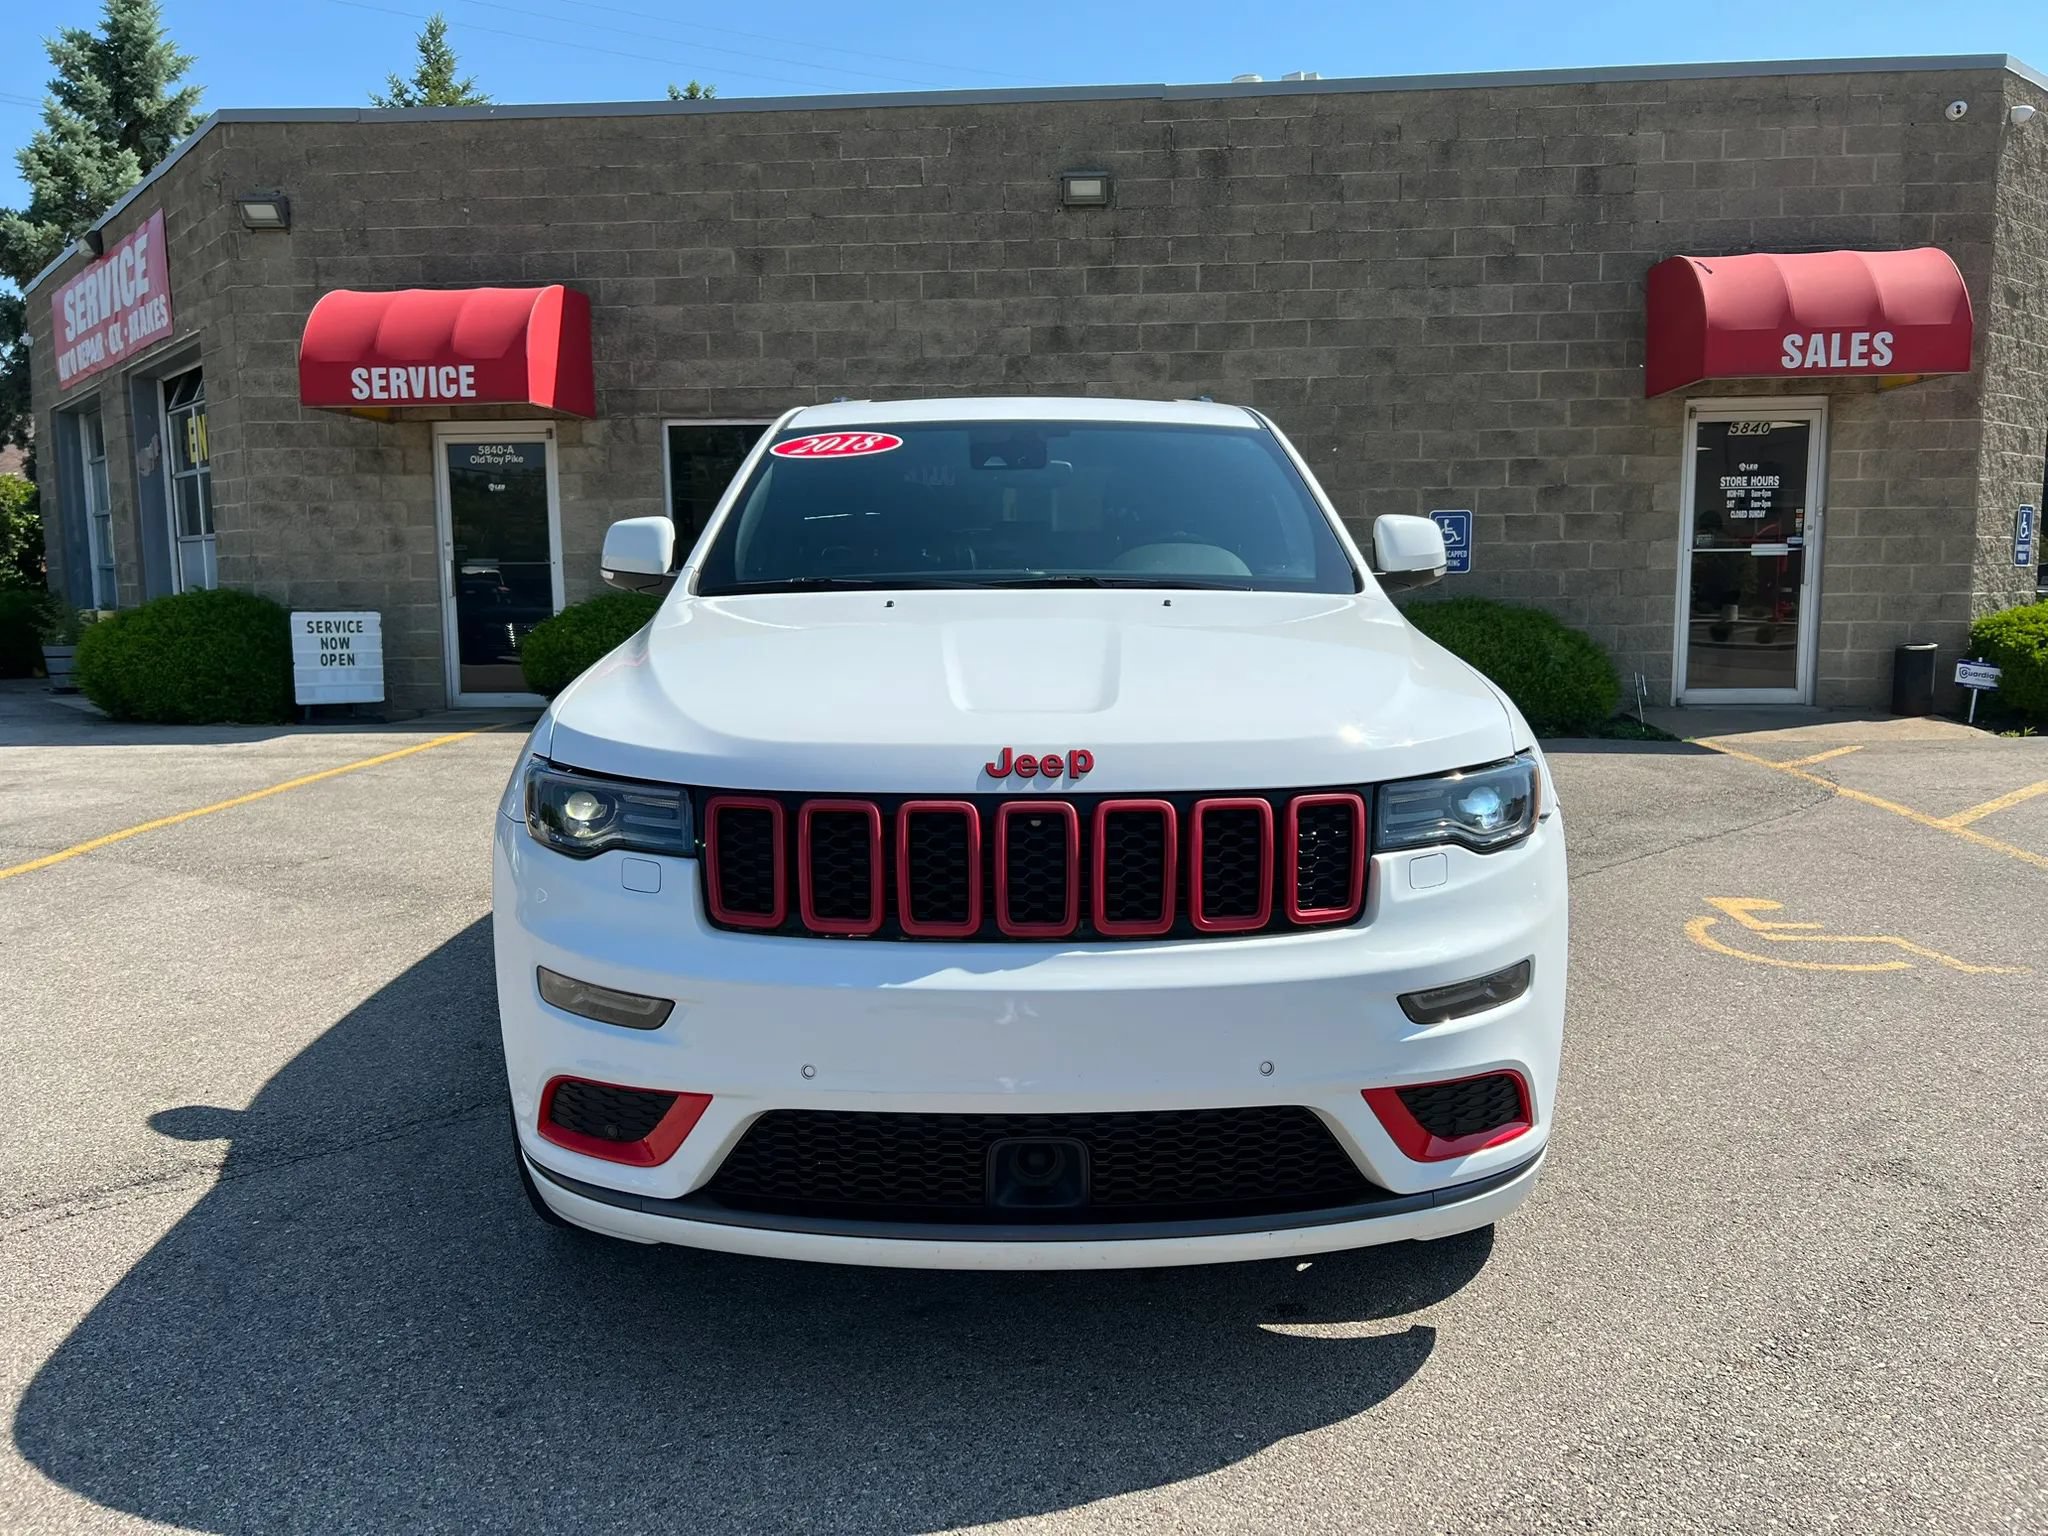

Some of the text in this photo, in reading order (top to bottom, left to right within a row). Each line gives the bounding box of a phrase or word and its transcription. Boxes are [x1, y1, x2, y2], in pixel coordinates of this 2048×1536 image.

[64, 233, 149, 342] SERVICE
[1781, 331, 1894, 369] SALES
[351, 365, 476, 400] SERVICE
[1730, 422, 1770, 434] 5840
[478, 445, 514, 455] 5840-A
[788, 436, 883, 454] 2018
[470, 454, 524, 465] Old Troy Pike
[1720, 475, 1780, 487] STORE HOURS
[1447, 550, 1468, 558] CAPPED
[306, 620, 364, 634] SERVICE
[320, 637, 350, 650] NOW
[320, 653, 355, 667] OPEN
[985, 747, 1095, 779] Jeep
